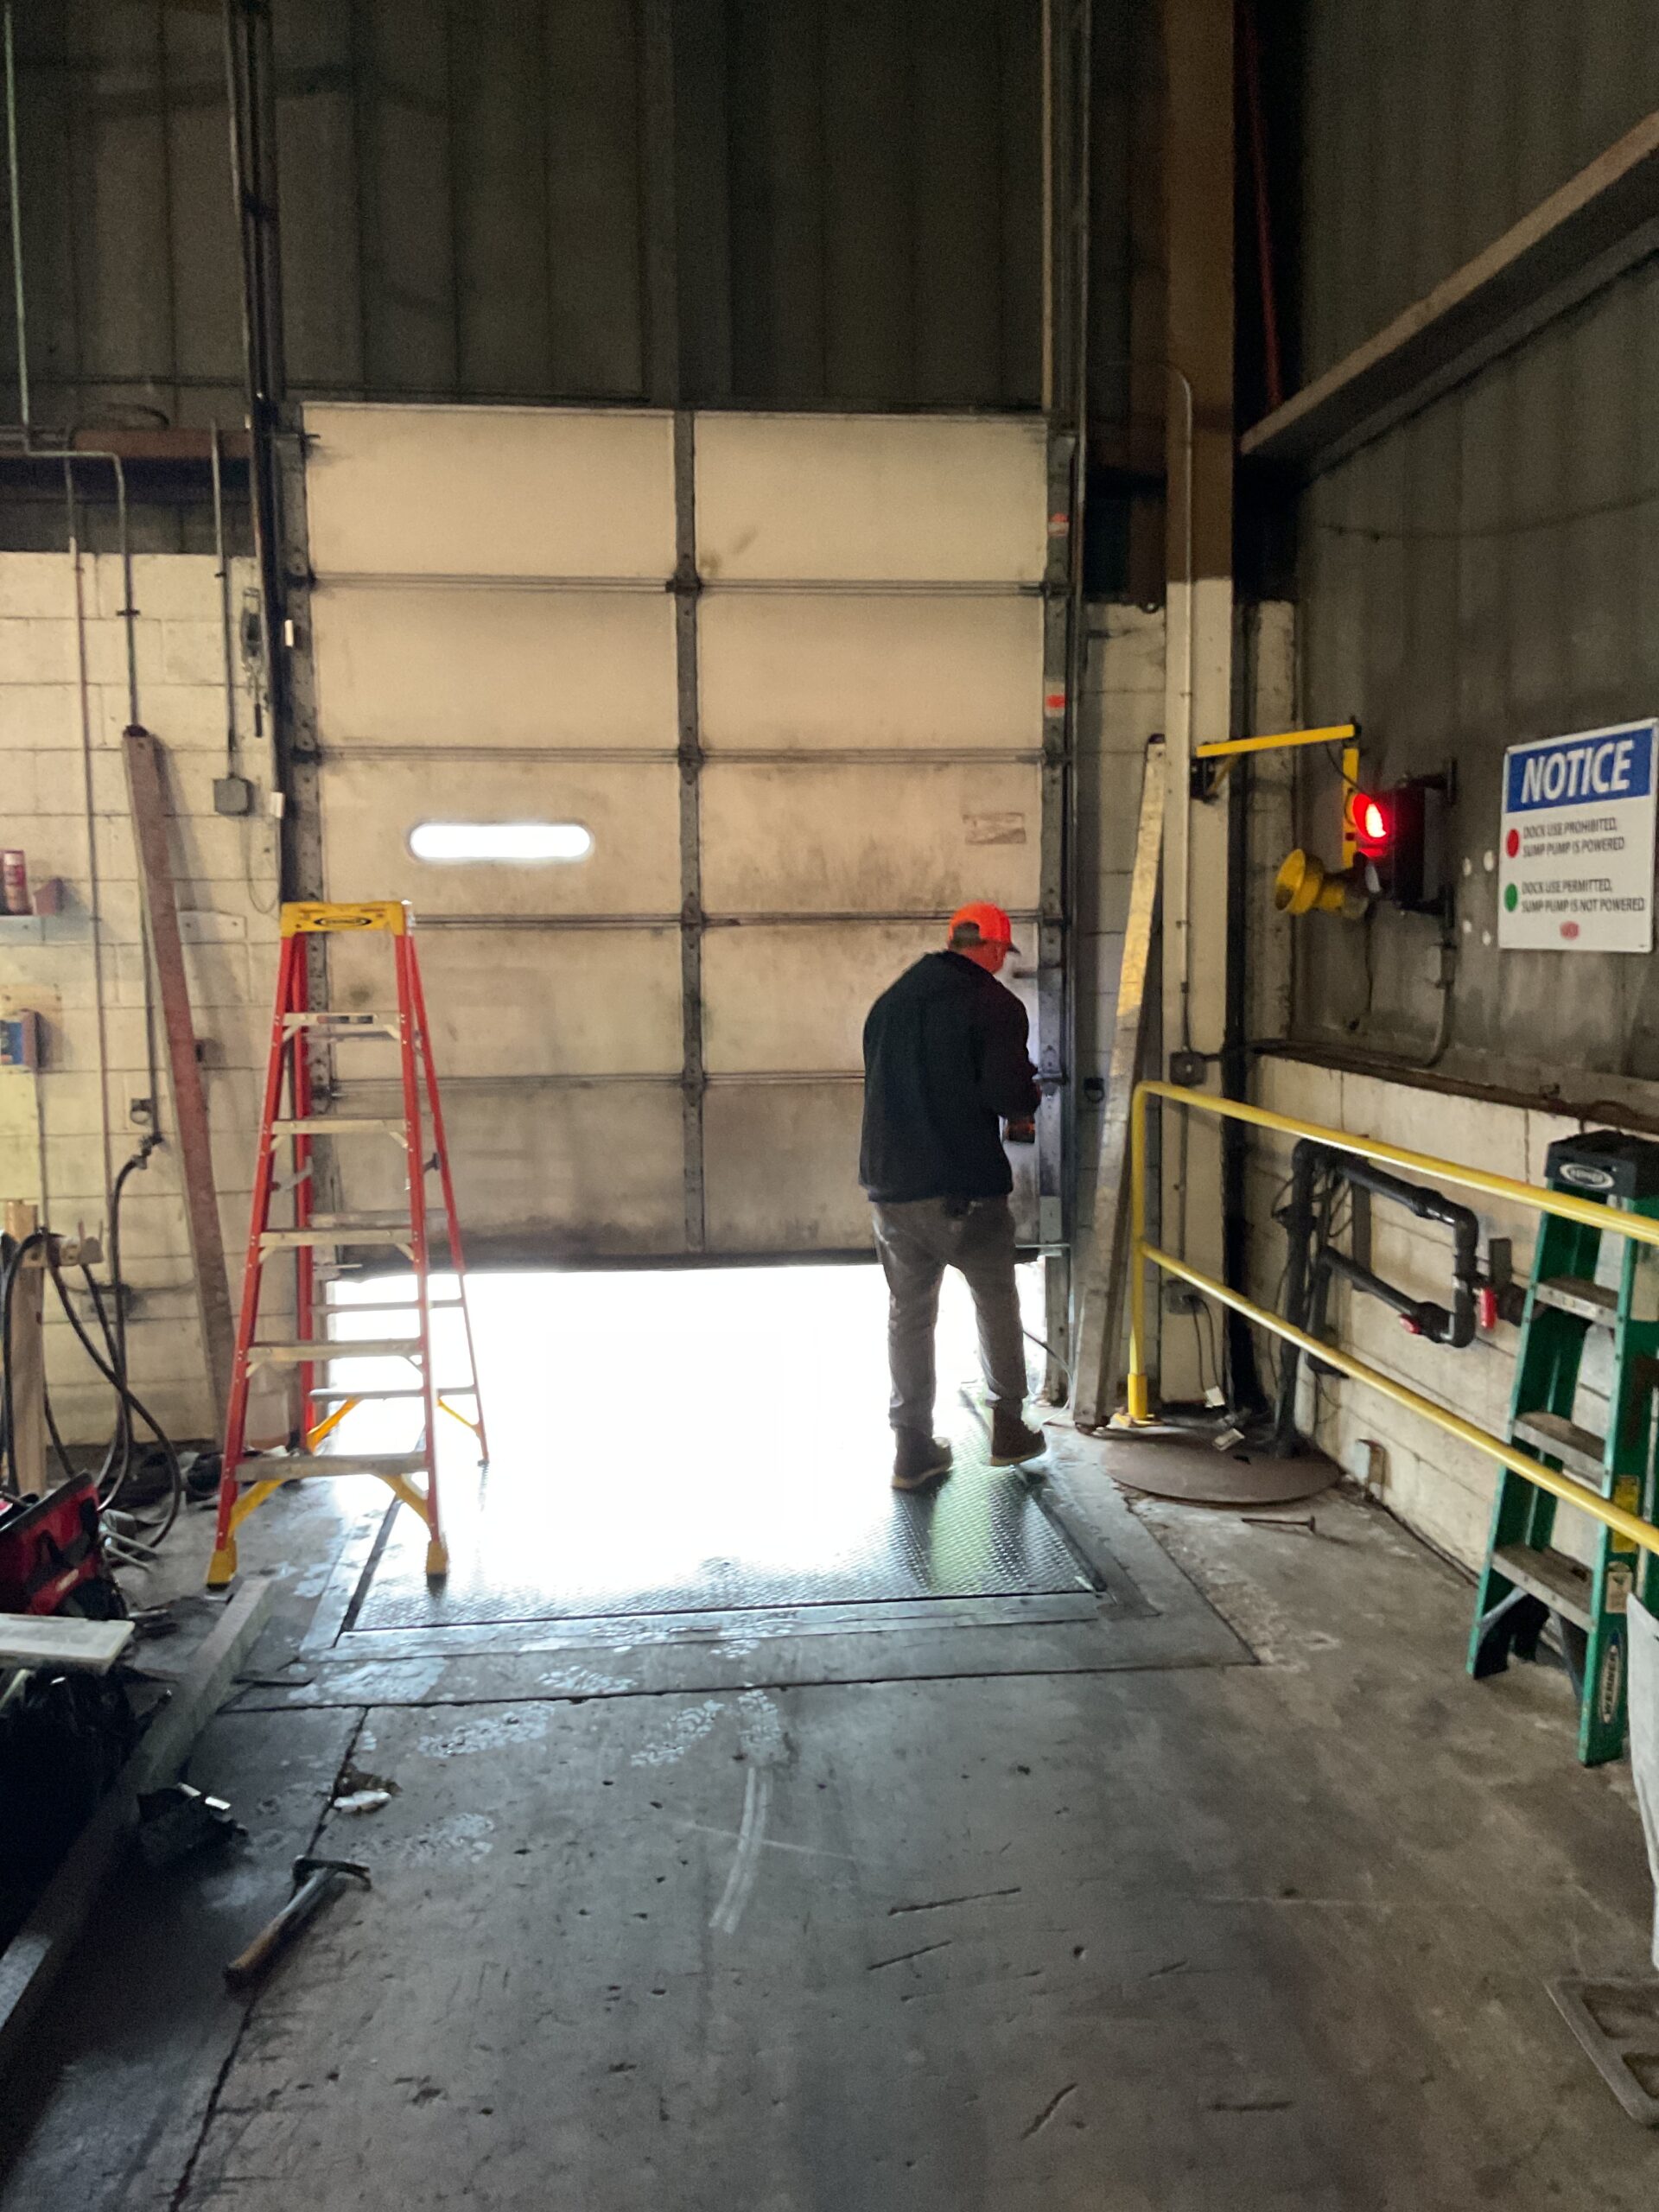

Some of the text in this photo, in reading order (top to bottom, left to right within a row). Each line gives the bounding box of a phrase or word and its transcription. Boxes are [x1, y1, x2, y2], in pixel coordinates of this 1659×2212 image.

[1521, 740, 1635, 804] NOTICE
[1523, 824, 1545, 839] DOCK
[1547, 823, 1562, 836] USE
[1523, 836, 1624, 857] SUMP PUMP IS POWERED
[1522, 881, 1543, 894] DOCK
[1545, 880, 1561, 893] USE
[1522, 897, 1644, 912] SUMP PUMP IS NOT POWERED
